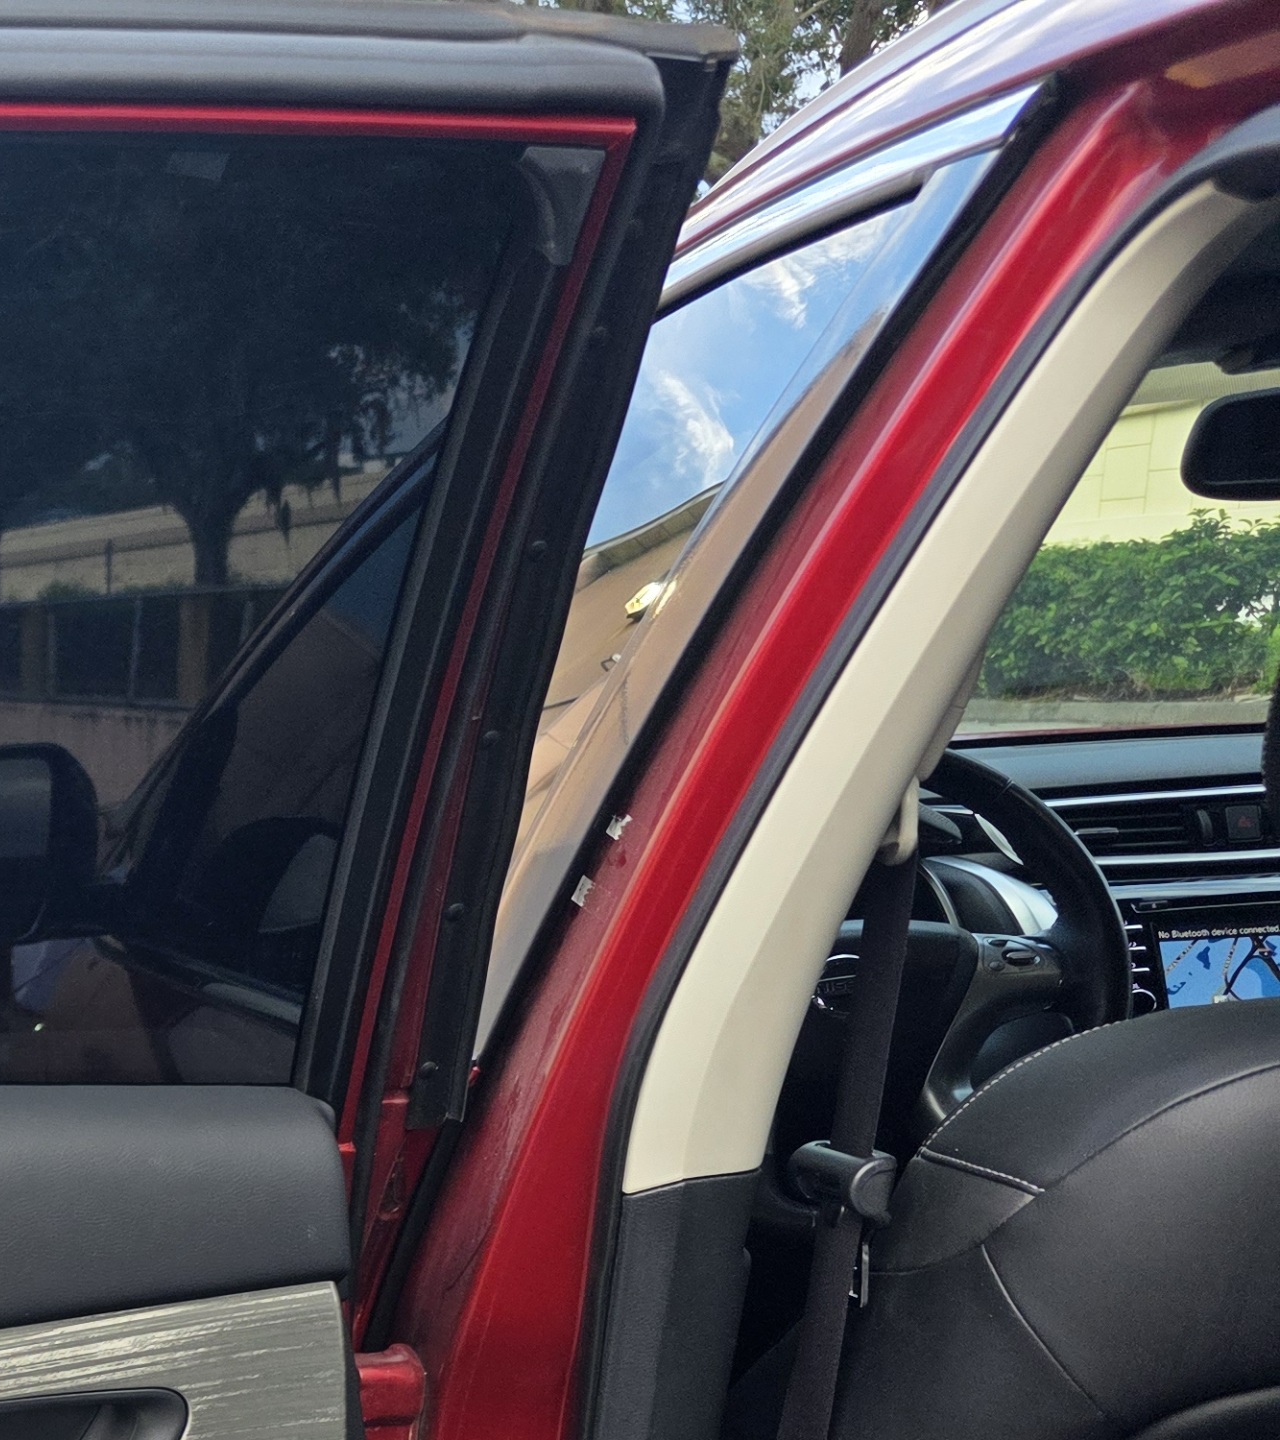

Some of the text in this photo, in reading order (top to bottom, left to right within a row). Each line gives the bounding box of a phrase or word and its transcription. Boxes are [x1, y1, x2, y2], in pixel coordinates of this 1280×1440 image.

[1157, 929, 1170, 939] No
[1171, 926, 1210, 938] Bluetooth
[1211, 925, 1238, 936] device
